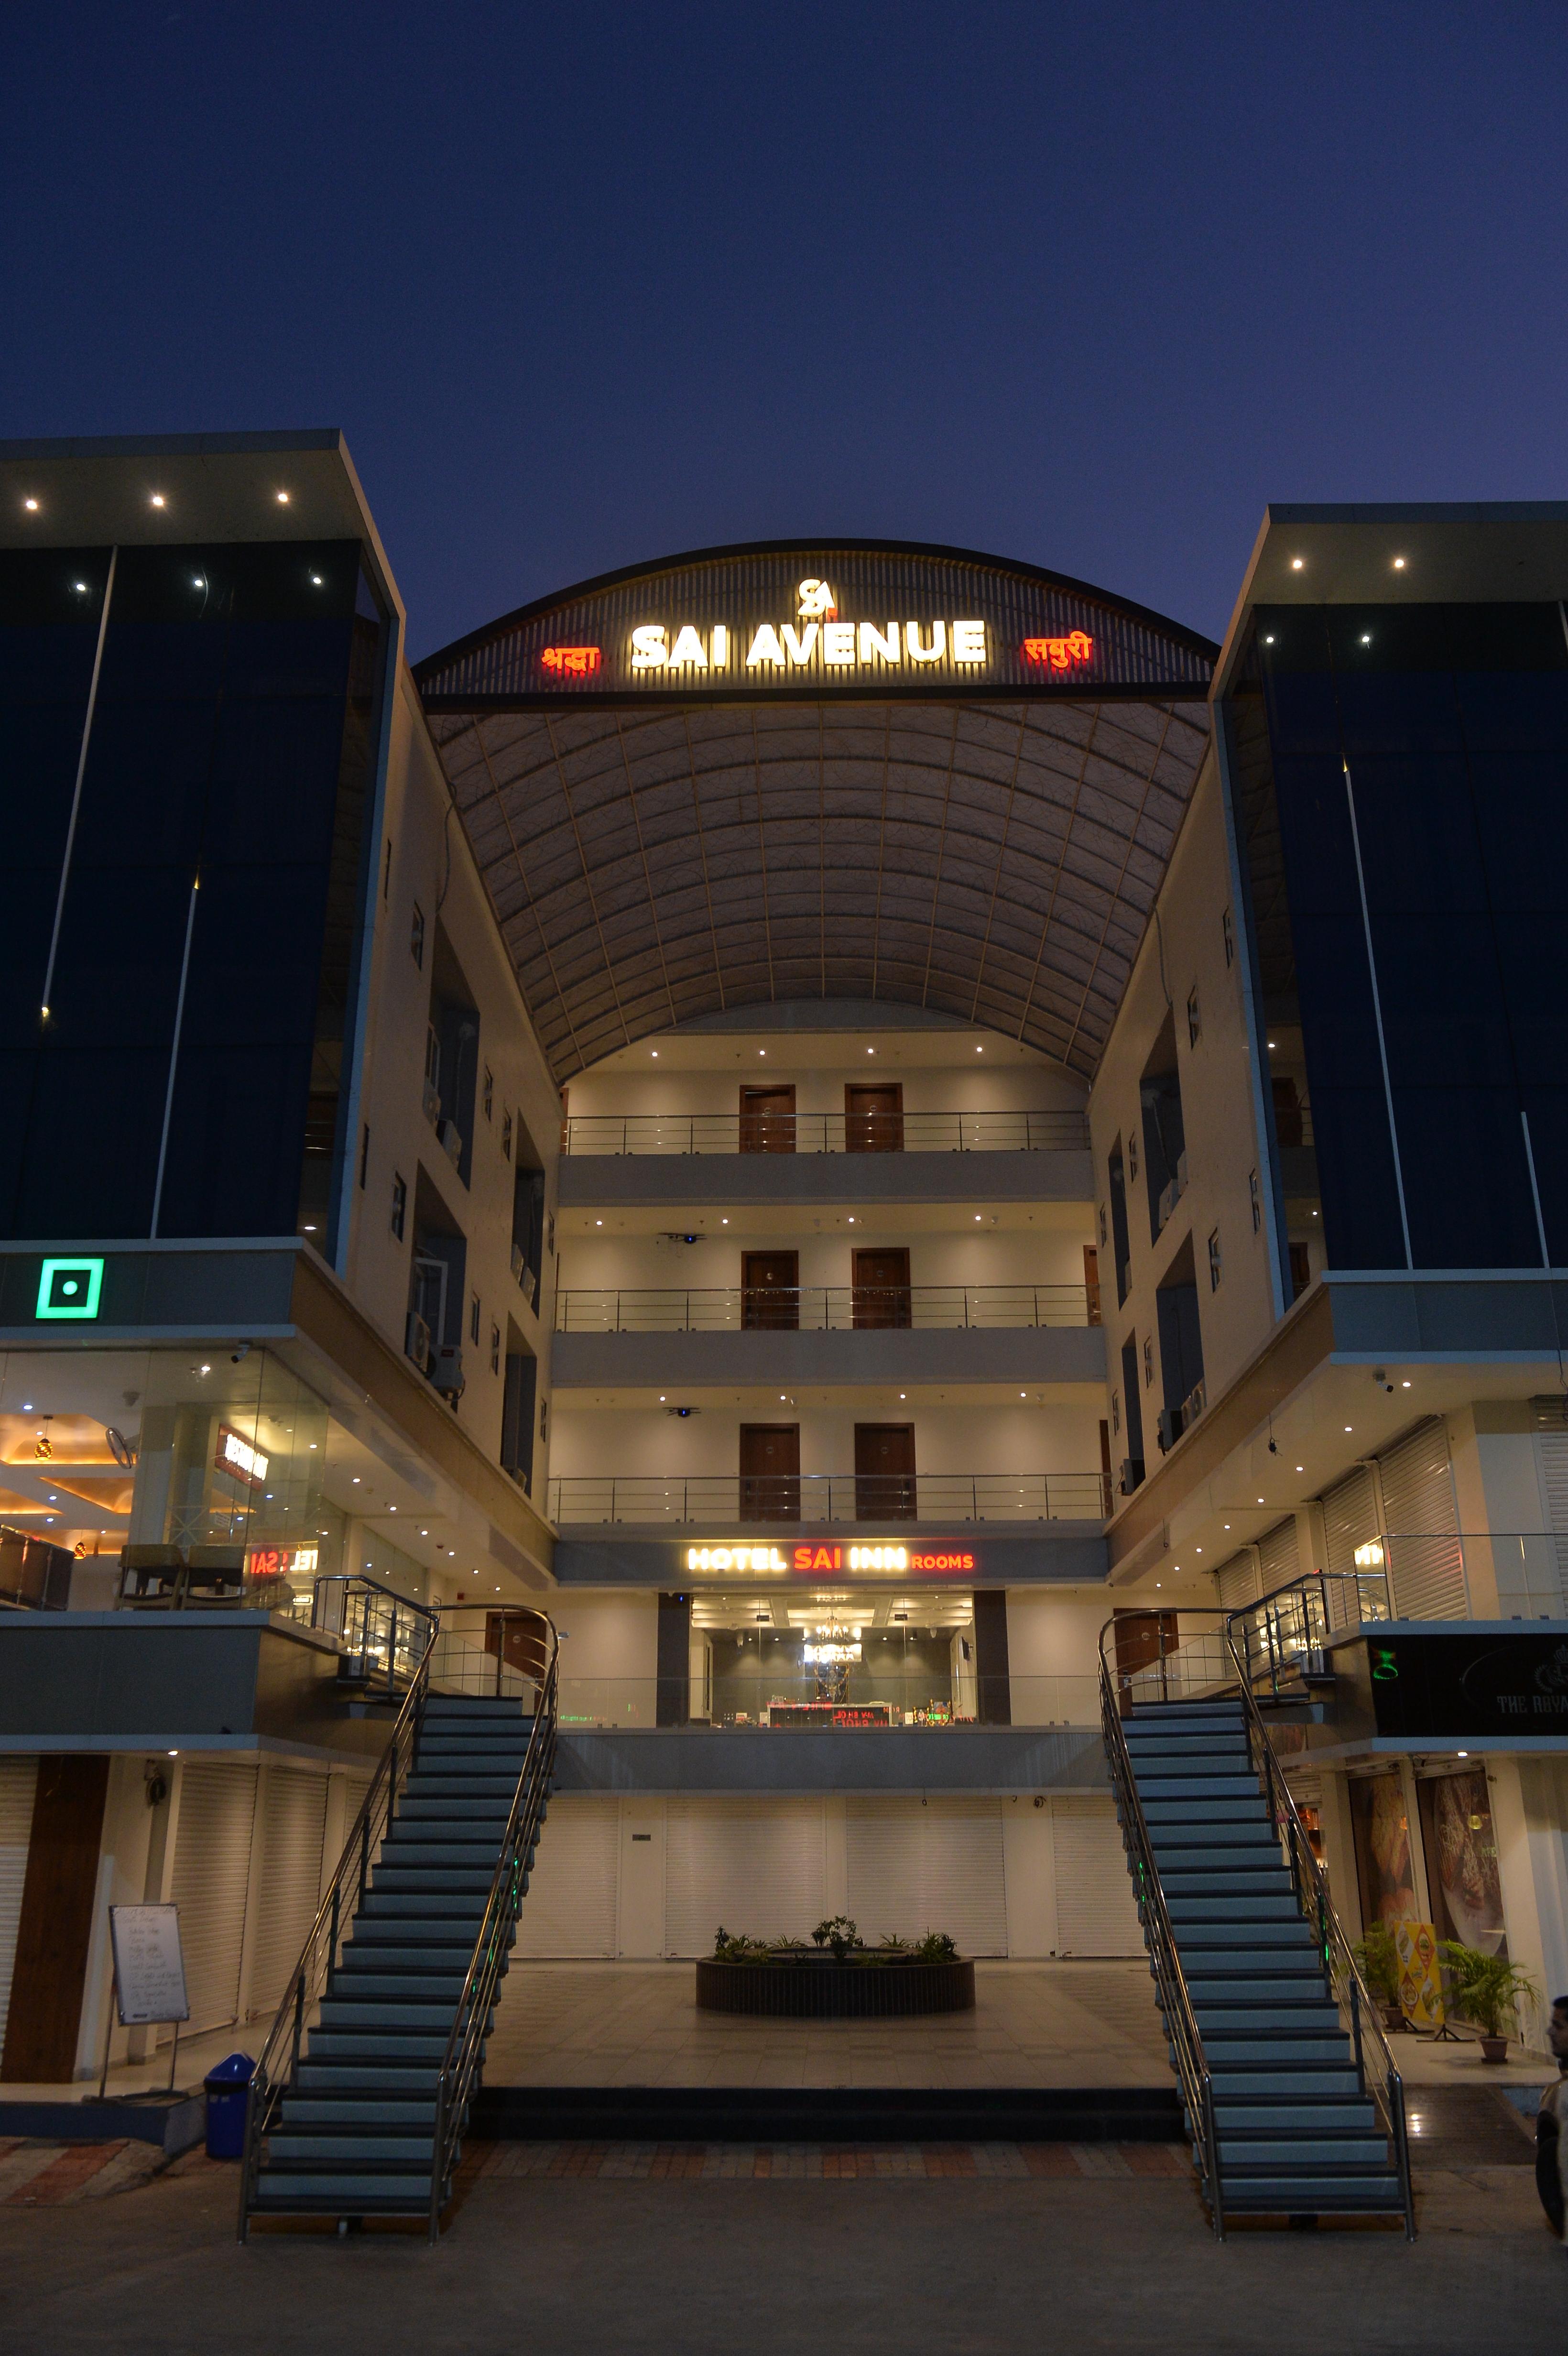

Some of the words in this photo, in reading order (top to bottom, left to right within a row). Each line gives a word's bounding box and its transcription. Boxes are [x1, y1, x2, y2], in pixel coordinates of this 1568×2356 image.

[631, 624, 726, 668] SAI
[746, 620, 986, 667] AVENUE
[1024, 631, 1092, 668] सबुरी
[541, 647, 600, 671] श्रद्धा
[688, 1547, 787, 1570] HOTEL
[794, 1547, 841, 1570] SAI
[850, 1547, 906, 1570] INN
[912, 1555, 974, 1570] ROOMS
[1497, 1695, 1528, 1713] THE
